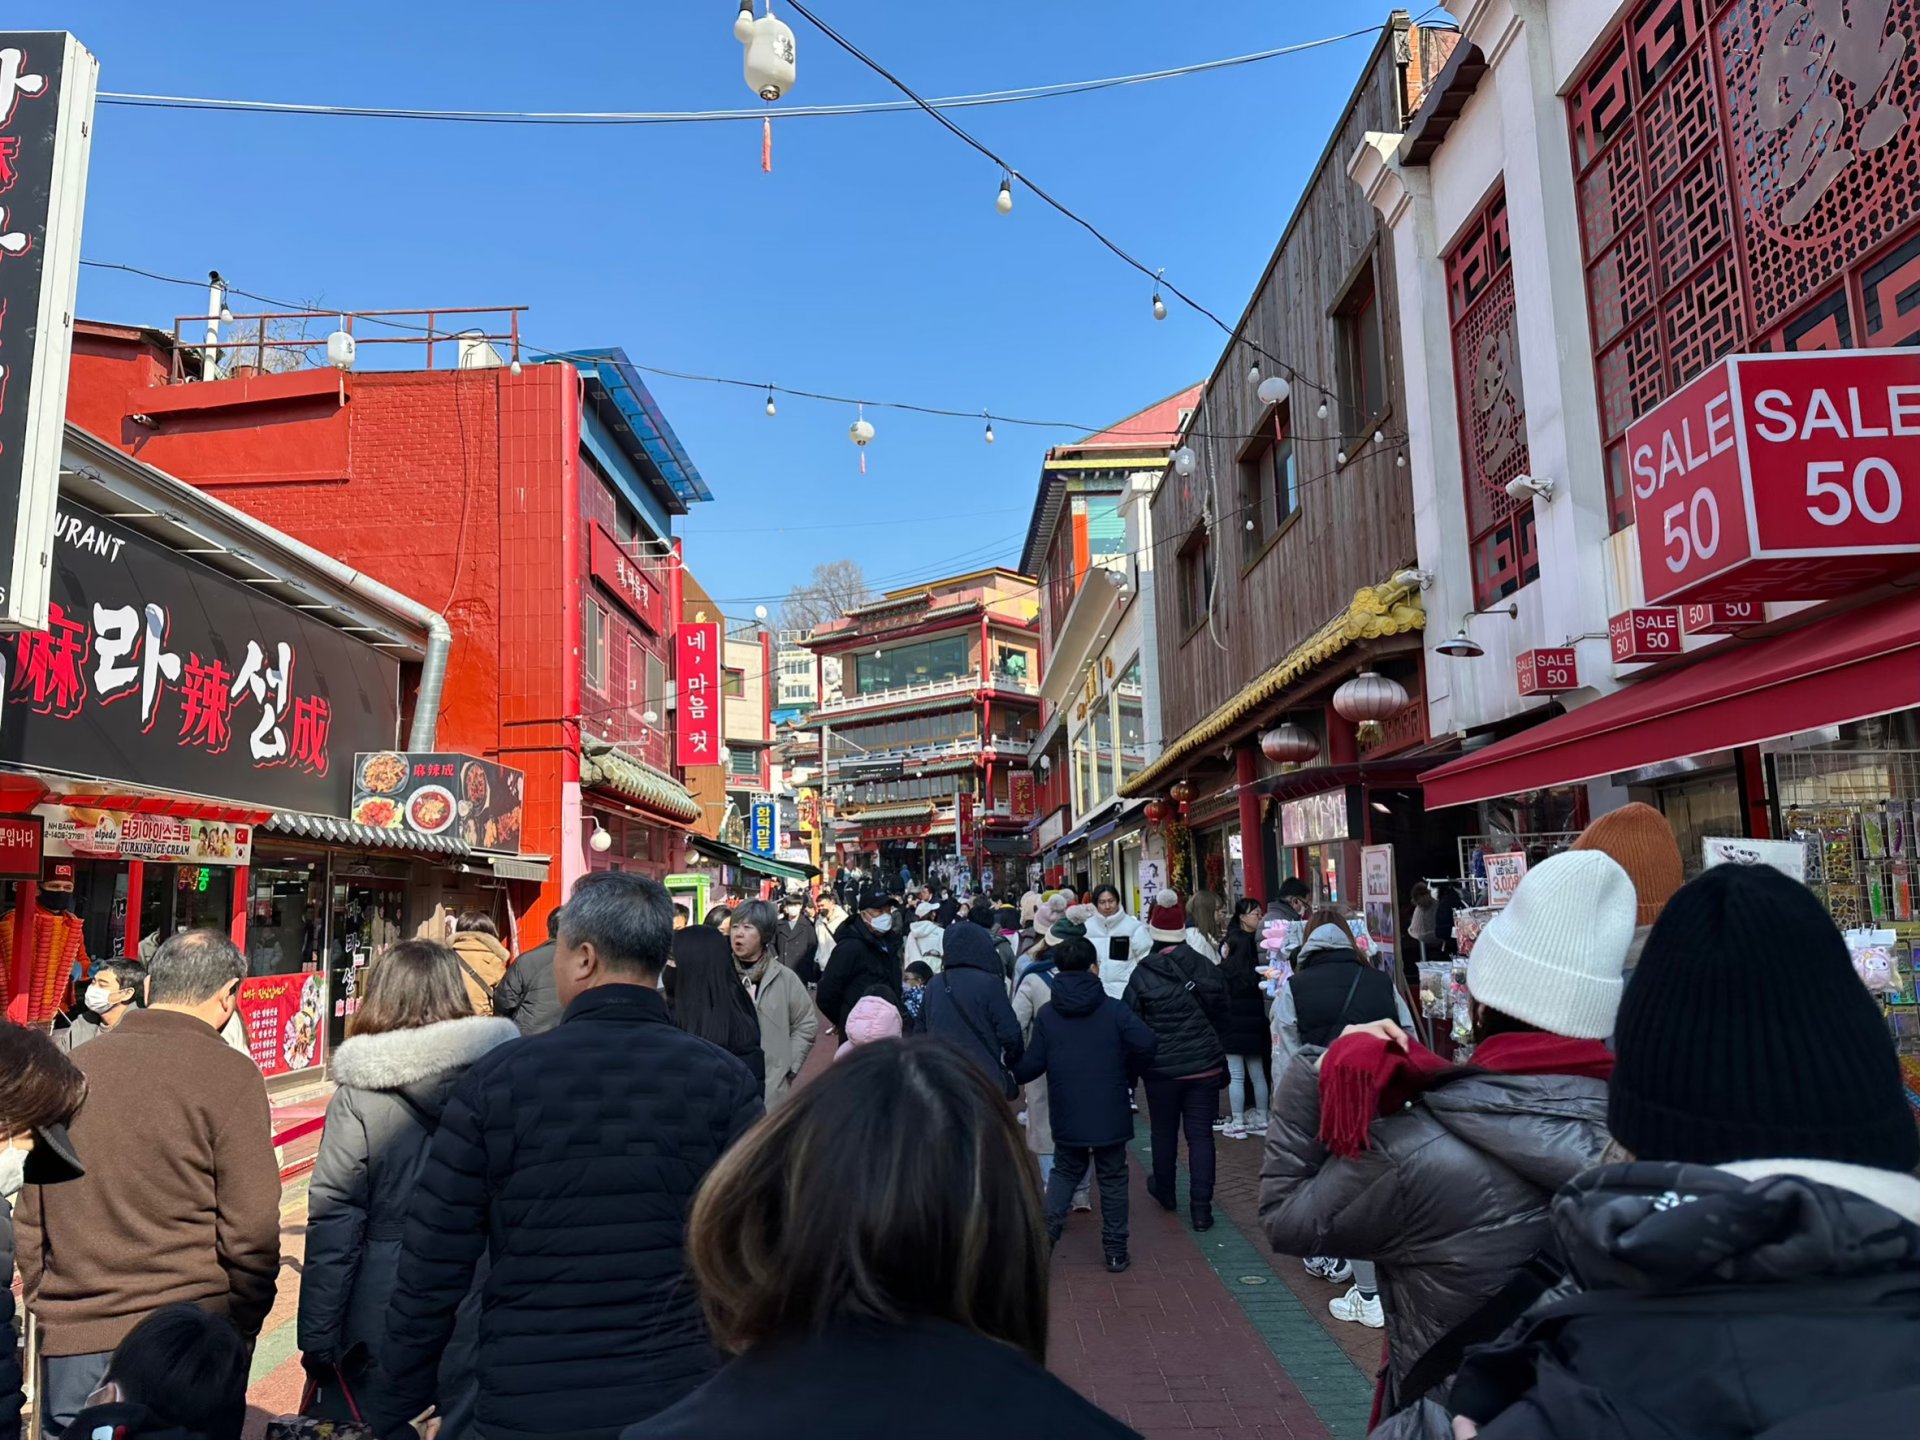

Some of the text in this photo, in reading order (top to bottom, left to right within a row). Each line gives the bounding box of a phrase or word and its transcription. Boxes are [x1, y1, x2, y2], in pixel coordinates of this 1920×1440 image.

[1754, 385, 1920, 442] SALE
[1633, 390, 1734, 499] SALE
[1806, 457, 1902, 526] 50
[1664, 487, 1720, 574] 50
[1635, 615, 1676, 629] SALE
[1689, 605, 1704, 625] 50
[1610, 617, 1631, 638] SALE
[1616, 636, 1629, 655] 50
[1646, 632, 1669, 648] 50
[1517, 656, 1533, 673] SALE
[1537, 654, 1574, 667] SALE
[1521, 672, 1532, 689] 50
[1547, 669, 1568, 684] 50
[120, 841, 190, 856] TURKISH ICE CREAM
